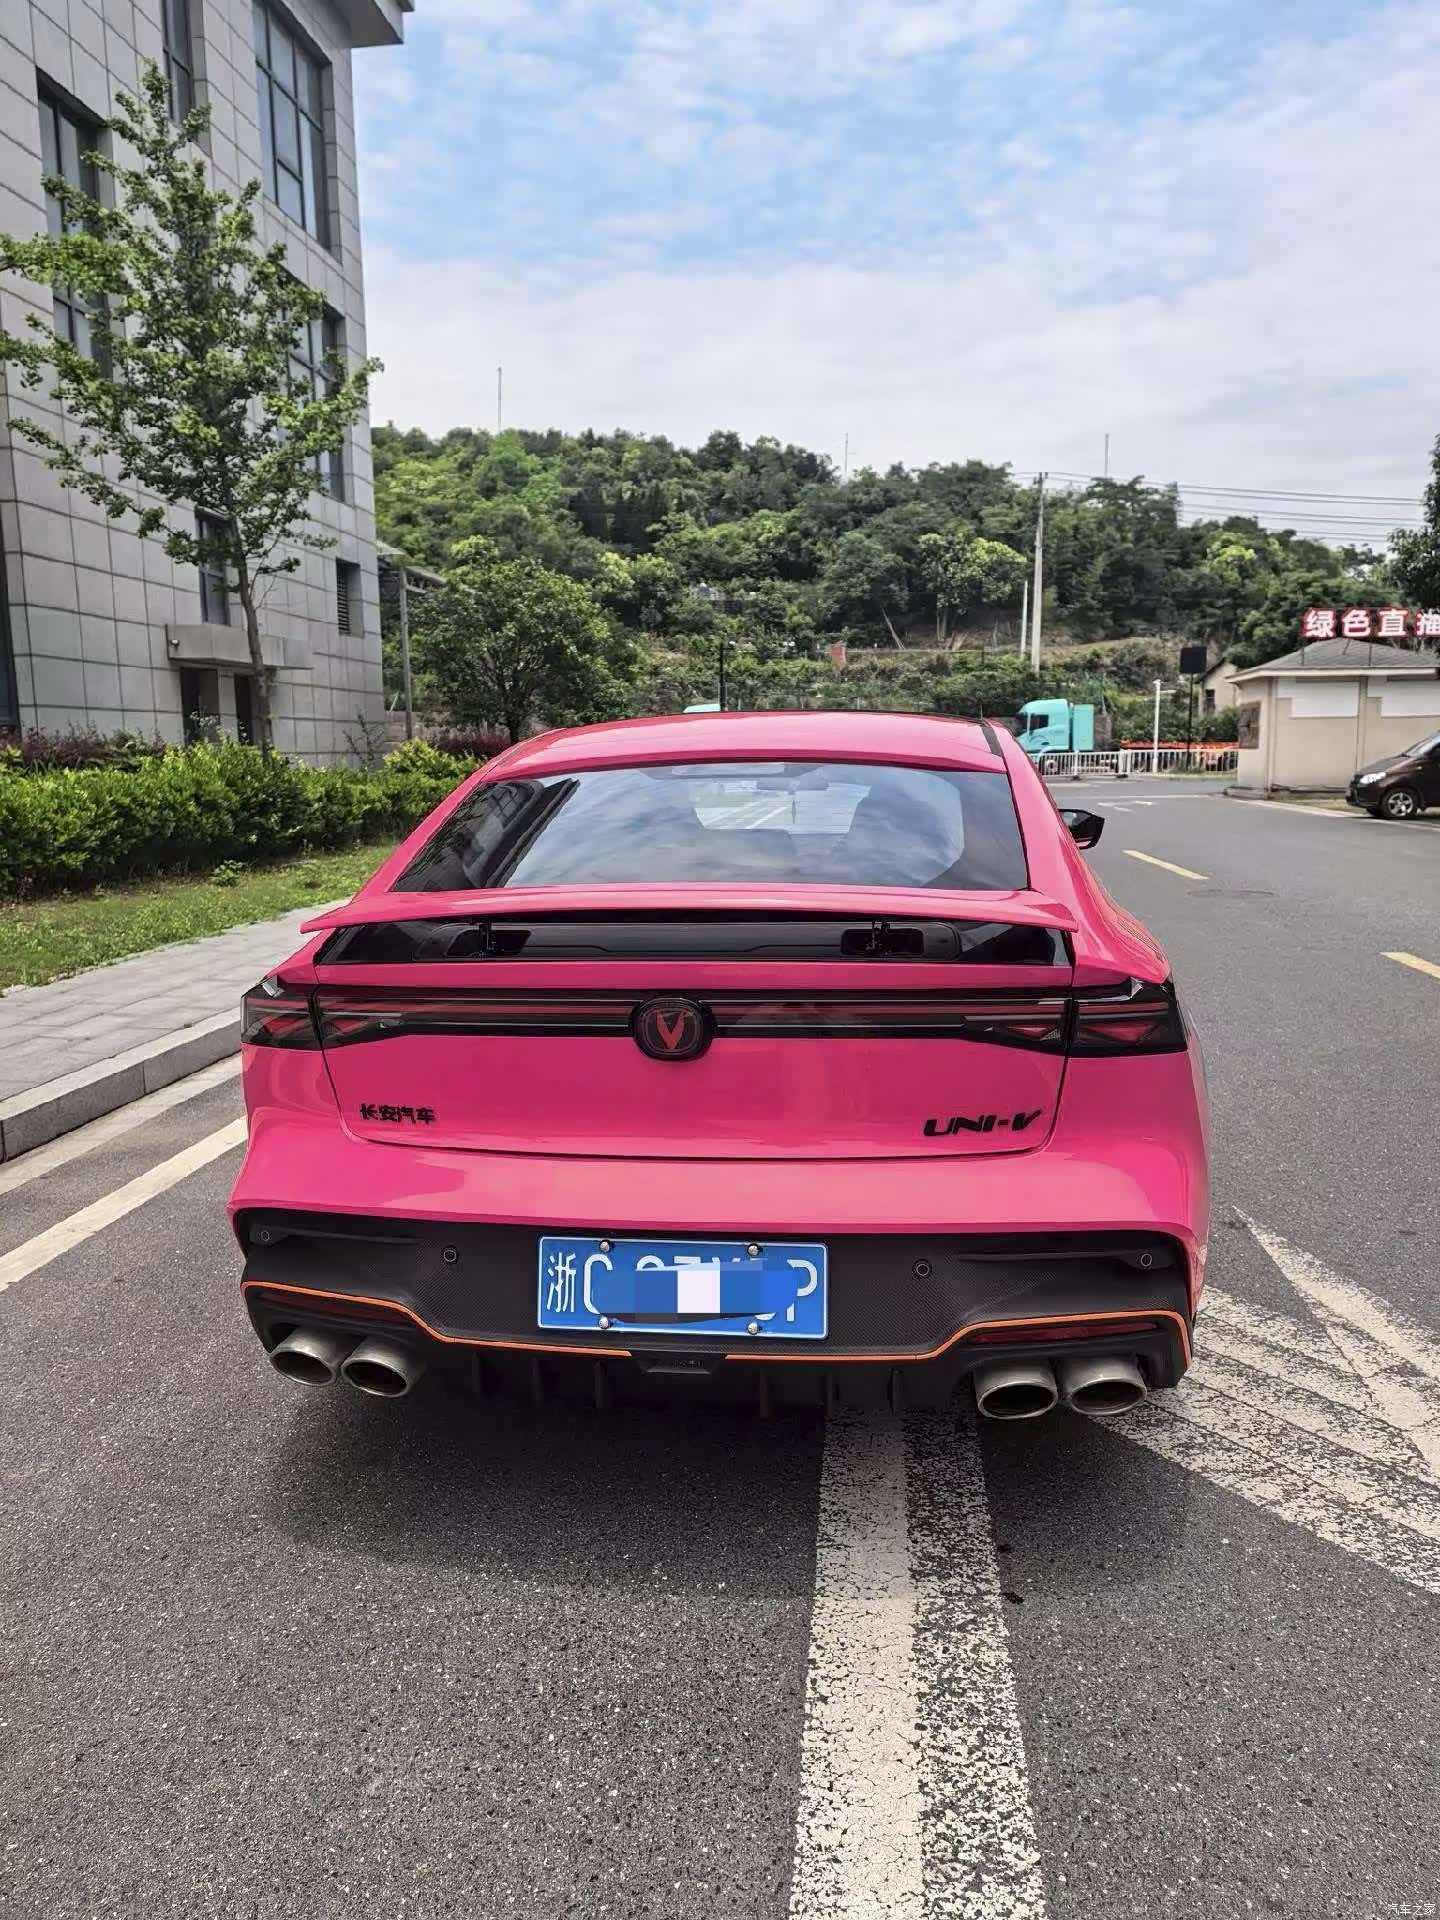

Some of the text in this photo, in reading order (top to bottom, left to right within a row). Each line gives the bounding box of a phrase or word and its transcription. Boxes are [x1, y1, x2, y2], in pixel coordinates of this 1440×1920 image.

[360, 1103, 436, 1124] 长安汽车
[924, 1109, 1042, 1136] UNI-V
